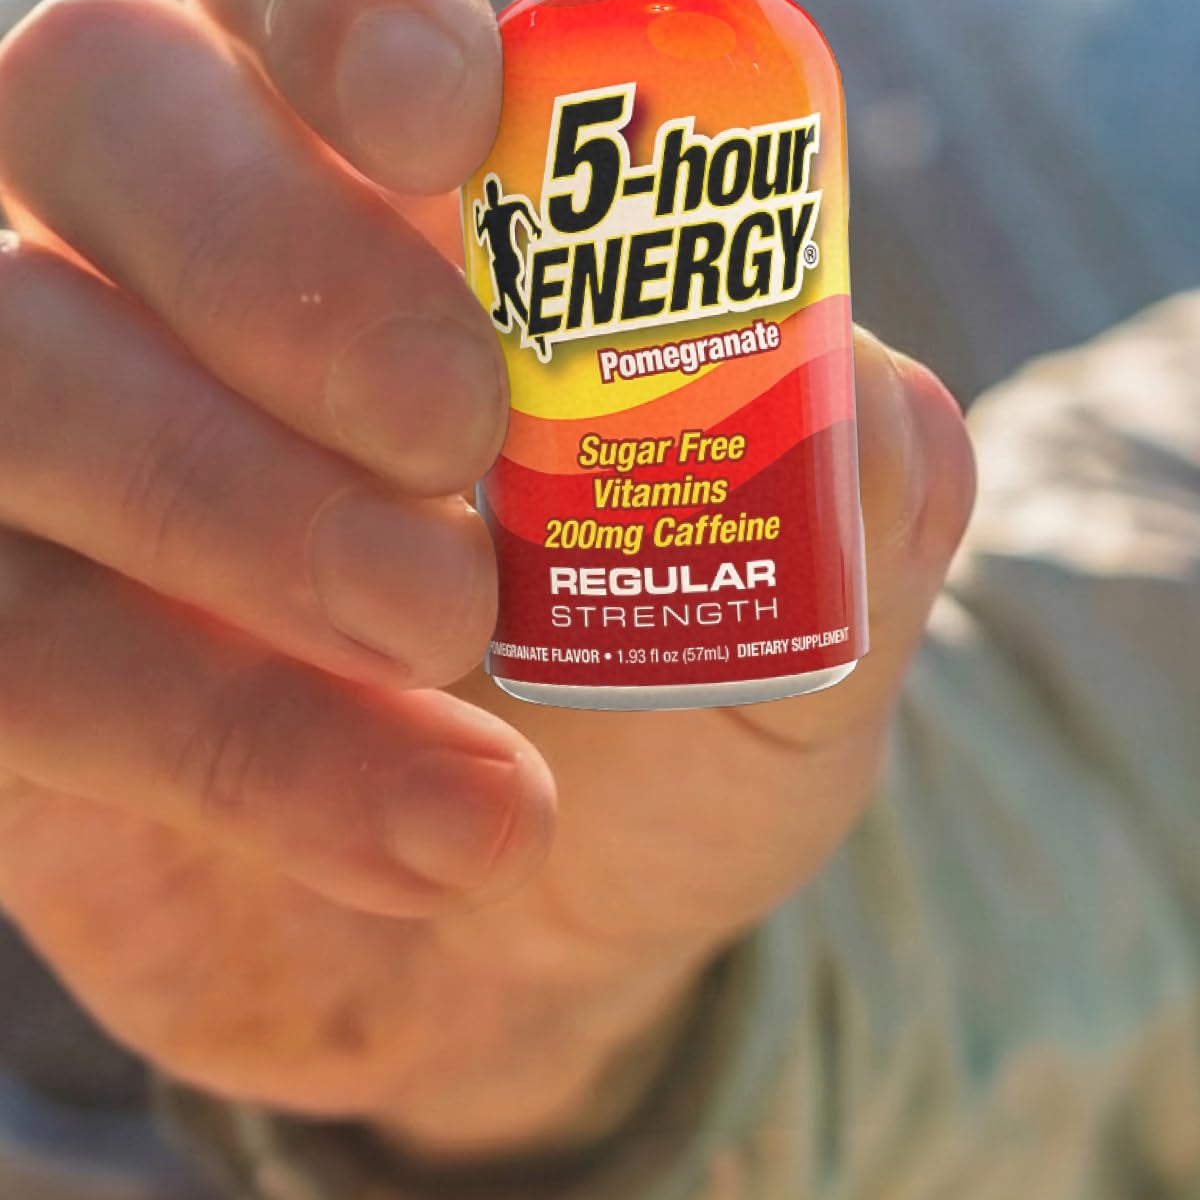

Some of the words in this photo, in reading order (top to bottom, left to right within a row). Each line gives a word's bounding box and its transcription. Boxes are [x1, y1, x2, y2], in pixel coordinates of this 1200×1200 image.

[548, 95, 815, 234] 5-hour
[600, 322, 780, 382] Pomegranate
[579, 435, 671, 471] Sugar
[679, 432, 746, 463] Free
[594, 477, 728, 509] Vitamins
[545, 520, 643, 555] 200mg
[653, 515, 780, 548] Caffeine
[550, 560, 777, 596] REGULAR
[551, 598, 779, 628] STRENGTH
[551, 648, 600, 663] FLAVOR
[617, 649, 646, 664] 1.93
[650, 649, 659, 663] fl
[663, 652, 679, 662] oz
[682, 646, 729, 663] (57mL)
[737, 639, 789, 658] DIETARY
[791, 627, 850, 652] SUPPLEMENT
